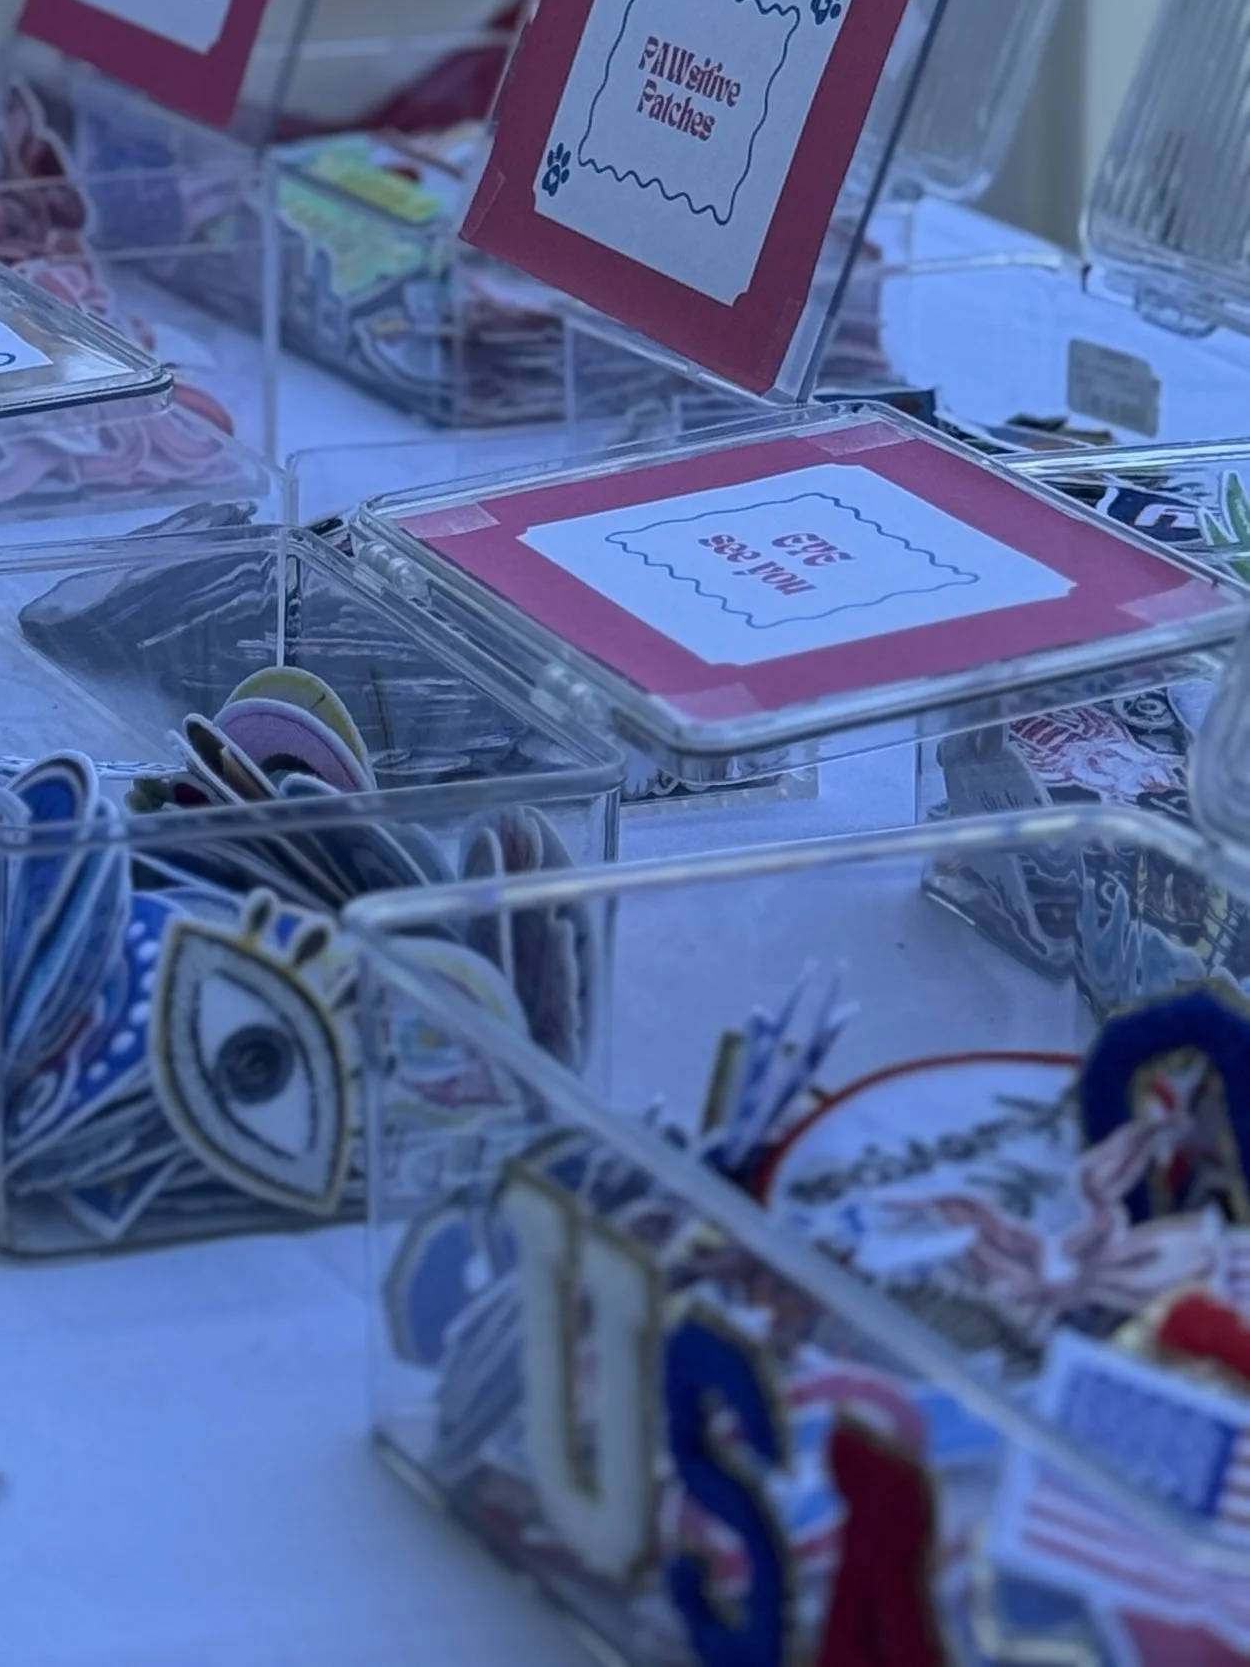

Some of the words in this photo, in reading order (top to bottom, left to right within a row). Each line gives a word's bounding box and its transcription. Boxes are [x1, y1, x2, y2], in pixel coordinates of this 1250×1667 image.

[638, 35, 741, 108] PAWsitive
[637, 78, 716, 142] Patches
[697, 534, 762, 564] see
[731, 560, 818, 596] you
